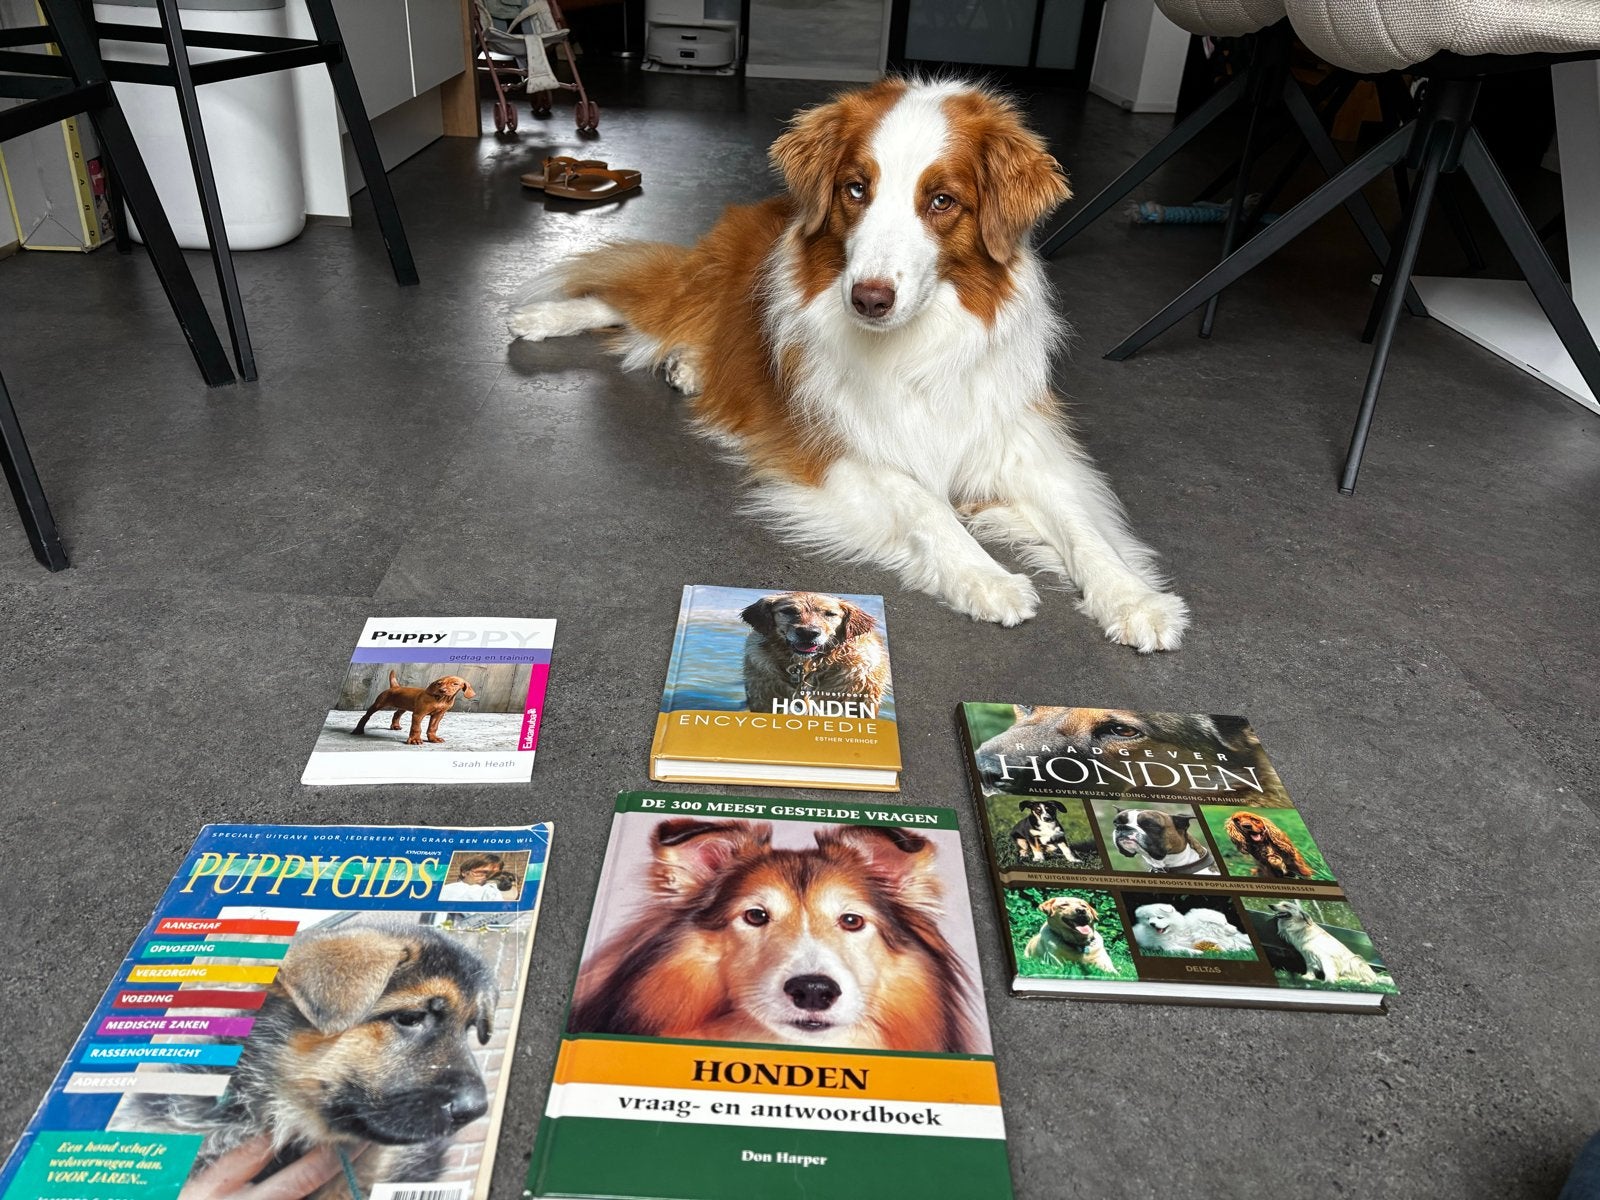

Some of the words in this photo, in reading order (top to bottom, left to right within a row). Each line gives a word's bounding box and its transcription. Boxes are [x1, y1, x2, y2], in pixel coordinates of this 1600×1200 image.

[371, 631, 448, 643] Puppy
[449, 654, 482, 662] gedrag
[499, 654, 535, 662] training
[772, 697, 876, 719] HONDEN
[679, 714, 877, 734] ENCYCLOPEDIE
[522, 712, 536, 749] Eukanuba
[845, 737, 878, 745] VERHOEF
[1015, 742, 1228, 762] RAADGEVER
[452, 760, 480, 768] Sarah
[485, 760, 515, 768] Heath
[994, 753, 1264, 794] HONDEN
[641, 798, 666, 809] DE
[671, 799, 702, 811] 300
[706, 801, 767, 814] MEEST
[770, 805, 860, 819] GESTELDE
[865, 810, 938, 824] VRAGEN
[266, 833, 308, 841] UITGAVE
[181, 852, 440, 899] PUPPYGIDS
[1044, 874, 1087, 882] UITGEBREID
[162, 922, 221, 930] AANSCHAF
[150, 944, 215, 953] OPVOEDING
[136, 969, 206, 977] VERZORGING
[121, 994, 174, 1003] VOEDING
[105, 1020, 167, 1030] MEDISCHE
[169, 1020, 210, 1030] ZAKEN
[90, 1048, 202, 1058] RASSENOVERZICHT
[691, 1060, 870, 1091] HONDEN
[73, 1077, 137, 1087] ADRESSEN
[618, 1096, 701, 1118] vraag-
[710, 1101, 740, 1116] en
[751, 1103, 943, 1126] antwoordboek
[57, 1141, 83, 1153] Een
[84, 1141, 120, 1153] hond
[118, 1142, 157, 1157] schaf
[150, 1143, 167, 1157] je
[741, 1150, 772, 1162] Don
[776, 1151, 827, 1167] Harper
[47, 1171, 89, 1183] VOOR
